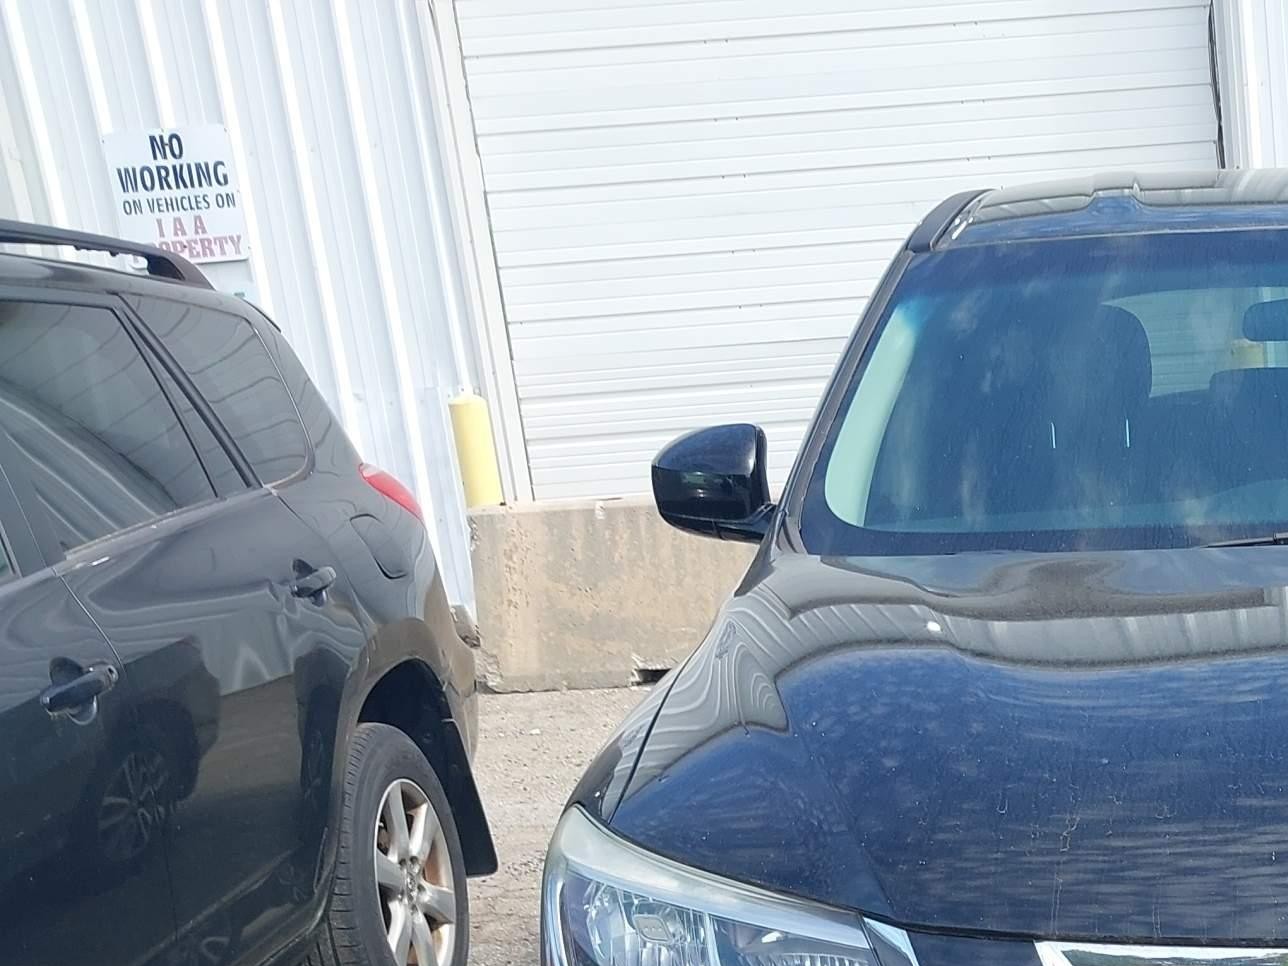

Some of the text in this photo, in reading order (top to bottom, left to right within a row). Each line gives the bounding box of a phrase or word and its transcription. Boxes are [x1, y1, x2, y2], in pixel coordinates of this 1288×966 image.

[148, 133, 184, 161] NO
[116, 160, 229, 193] WORKING
[122, 191, 236, 215] ON VEHICLES ON
[150, 234, 242, 260] OPERTY
